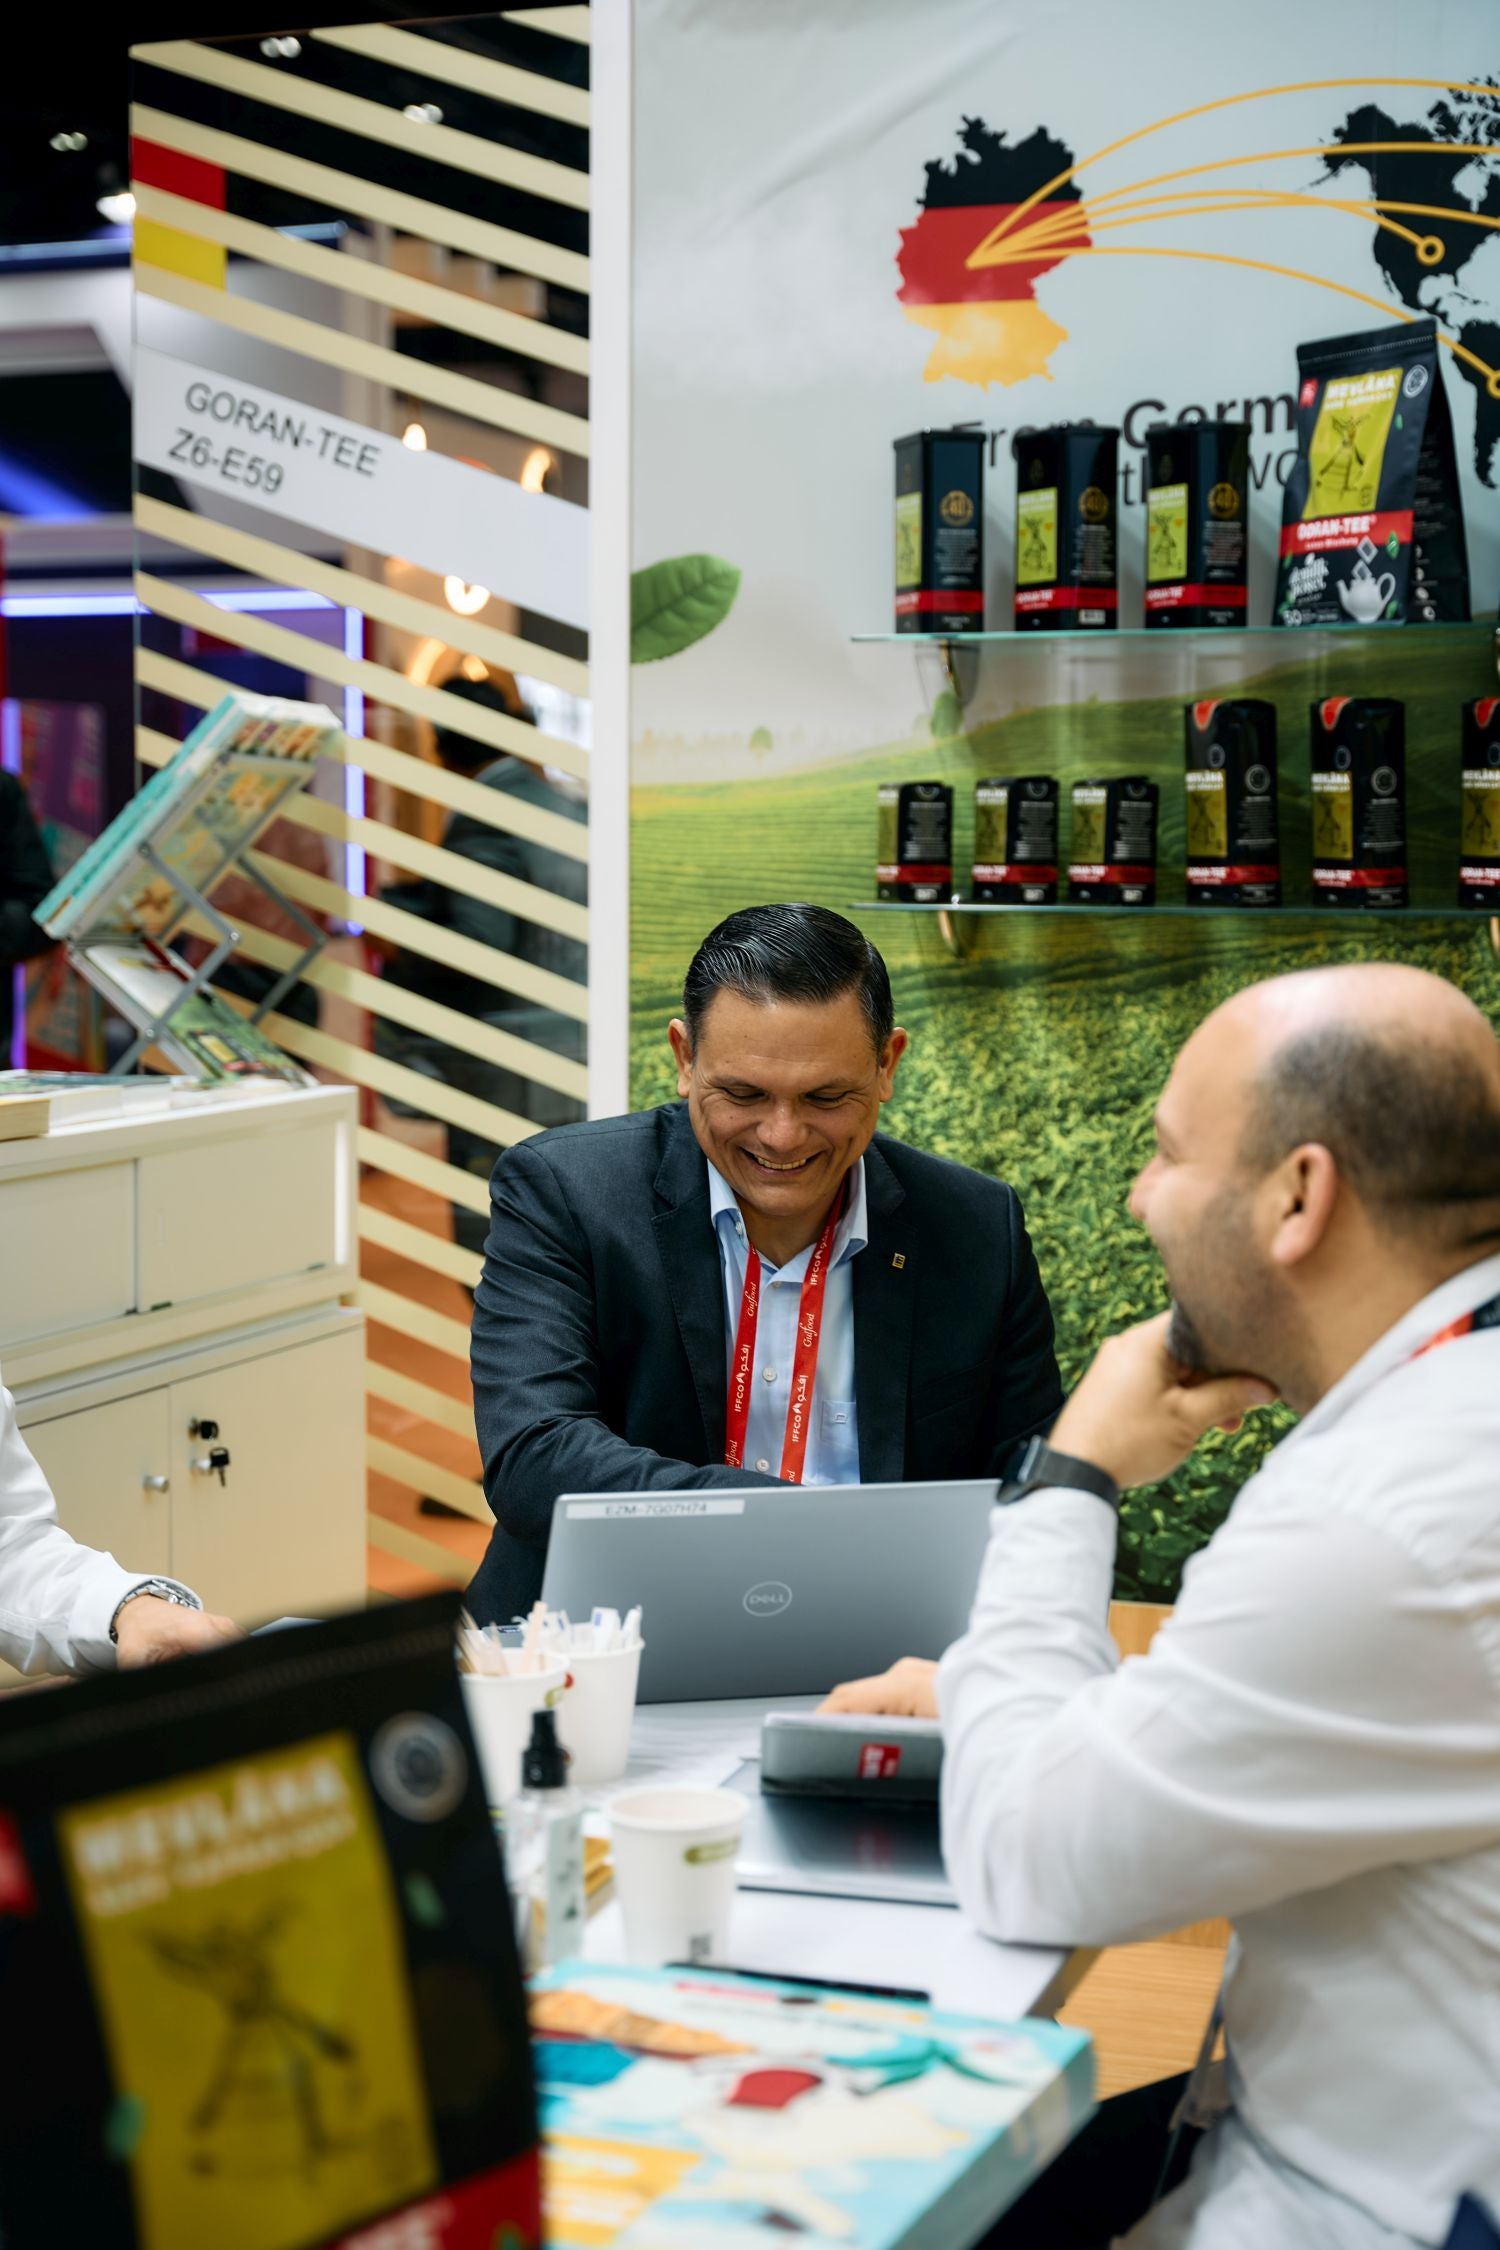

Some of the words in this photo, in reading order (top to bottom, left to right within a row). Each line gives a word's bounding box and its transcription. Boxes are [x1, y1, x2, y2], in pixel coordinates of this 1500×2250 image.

[184, 381, 382, 478] GORAN-TEE
[166, 427, 285, 495] Z6-E59
[809, 1260, 821, 1286] IFFCO
[744, 1281, 758, 1317] Gulfood
[800, 1312, 818, 1348] Gulfood
[734, 1384, 745, 1412] IFFCO
[791, 1414, 802, 1442] IFFCO
[725, 1439, 740, 1467] ulfood
[750, 1593, 787, 1605] DELL
